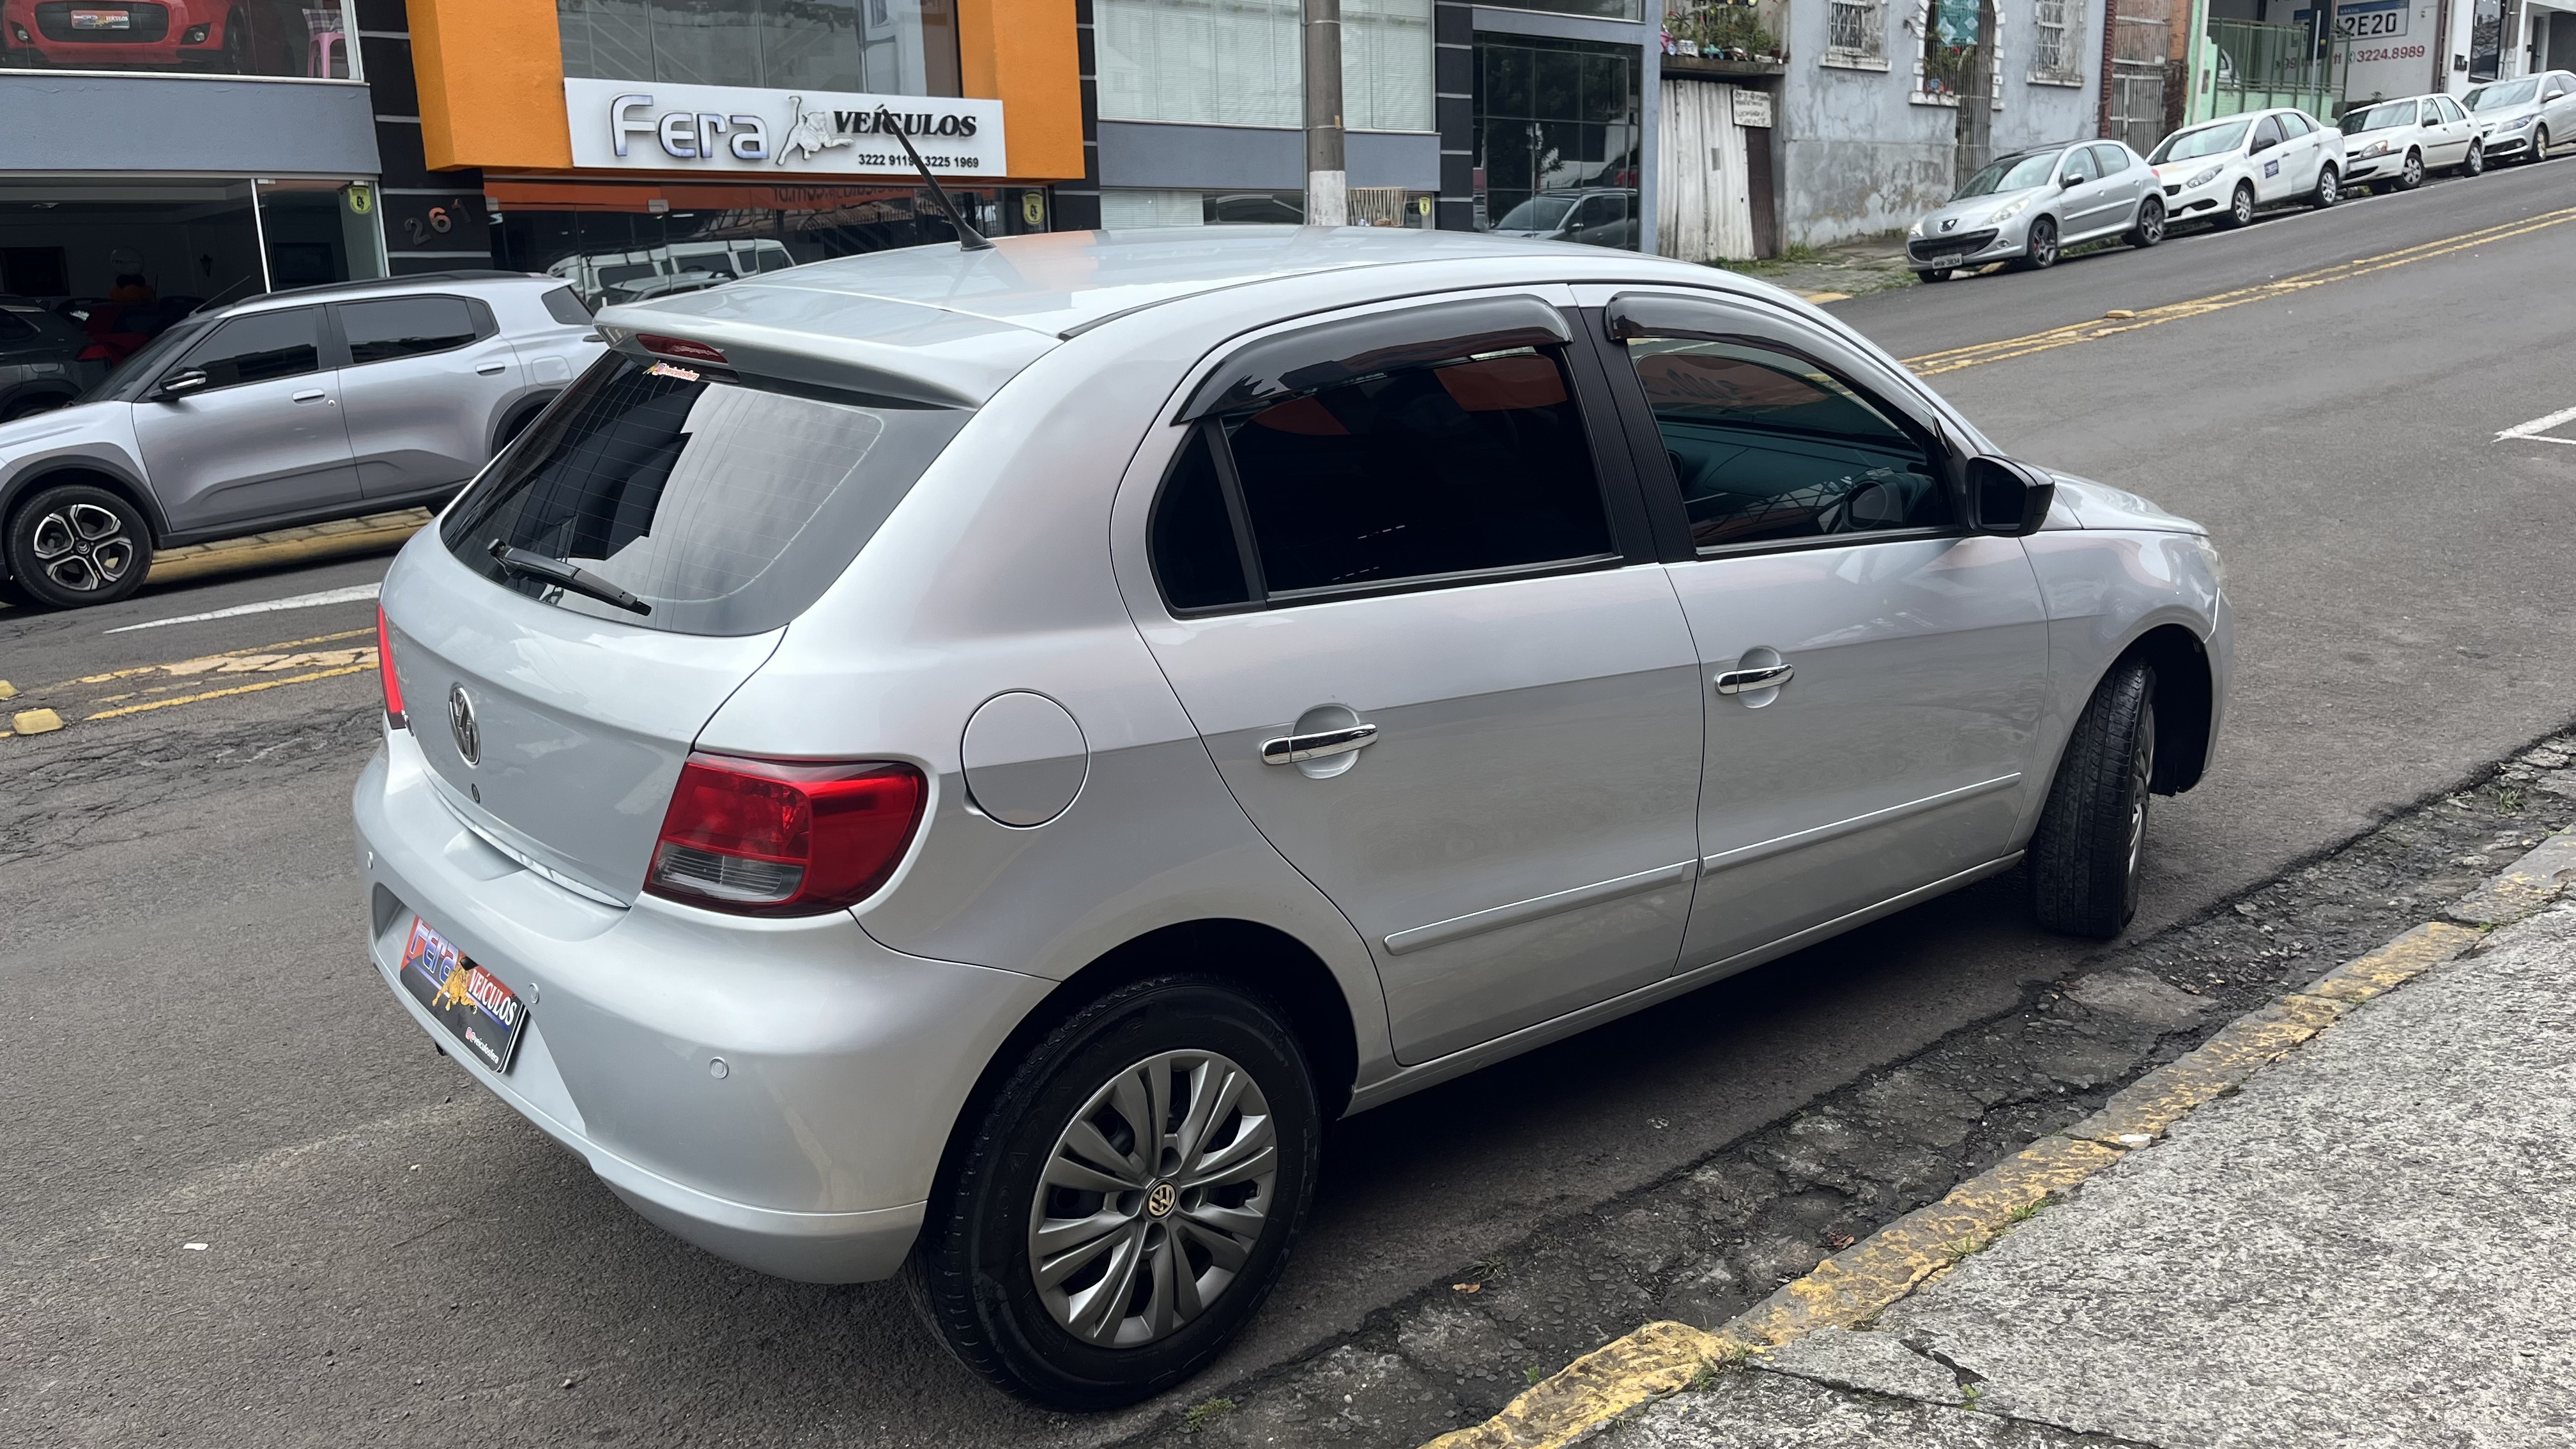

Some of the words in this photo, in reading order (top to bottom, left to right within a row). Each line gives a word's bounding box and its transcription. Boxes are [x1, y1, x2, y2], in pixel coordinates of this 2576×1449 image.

[2336, 12, 2396, 36] 2E20
[2356, 45, 2425, 63] 3224.8989
[833, 103, 977, 137] VEÍCULOS
[858, 153, 885, 165] 3222
[924, 156, 951, 167] 3225
[954, 157, 979, 168] 1969
[404, 198, 471, 245] 261
[468, 969, 517, 1026] VEÍCULOS
[471, 1031, 499, 1064] @veiculosfera
